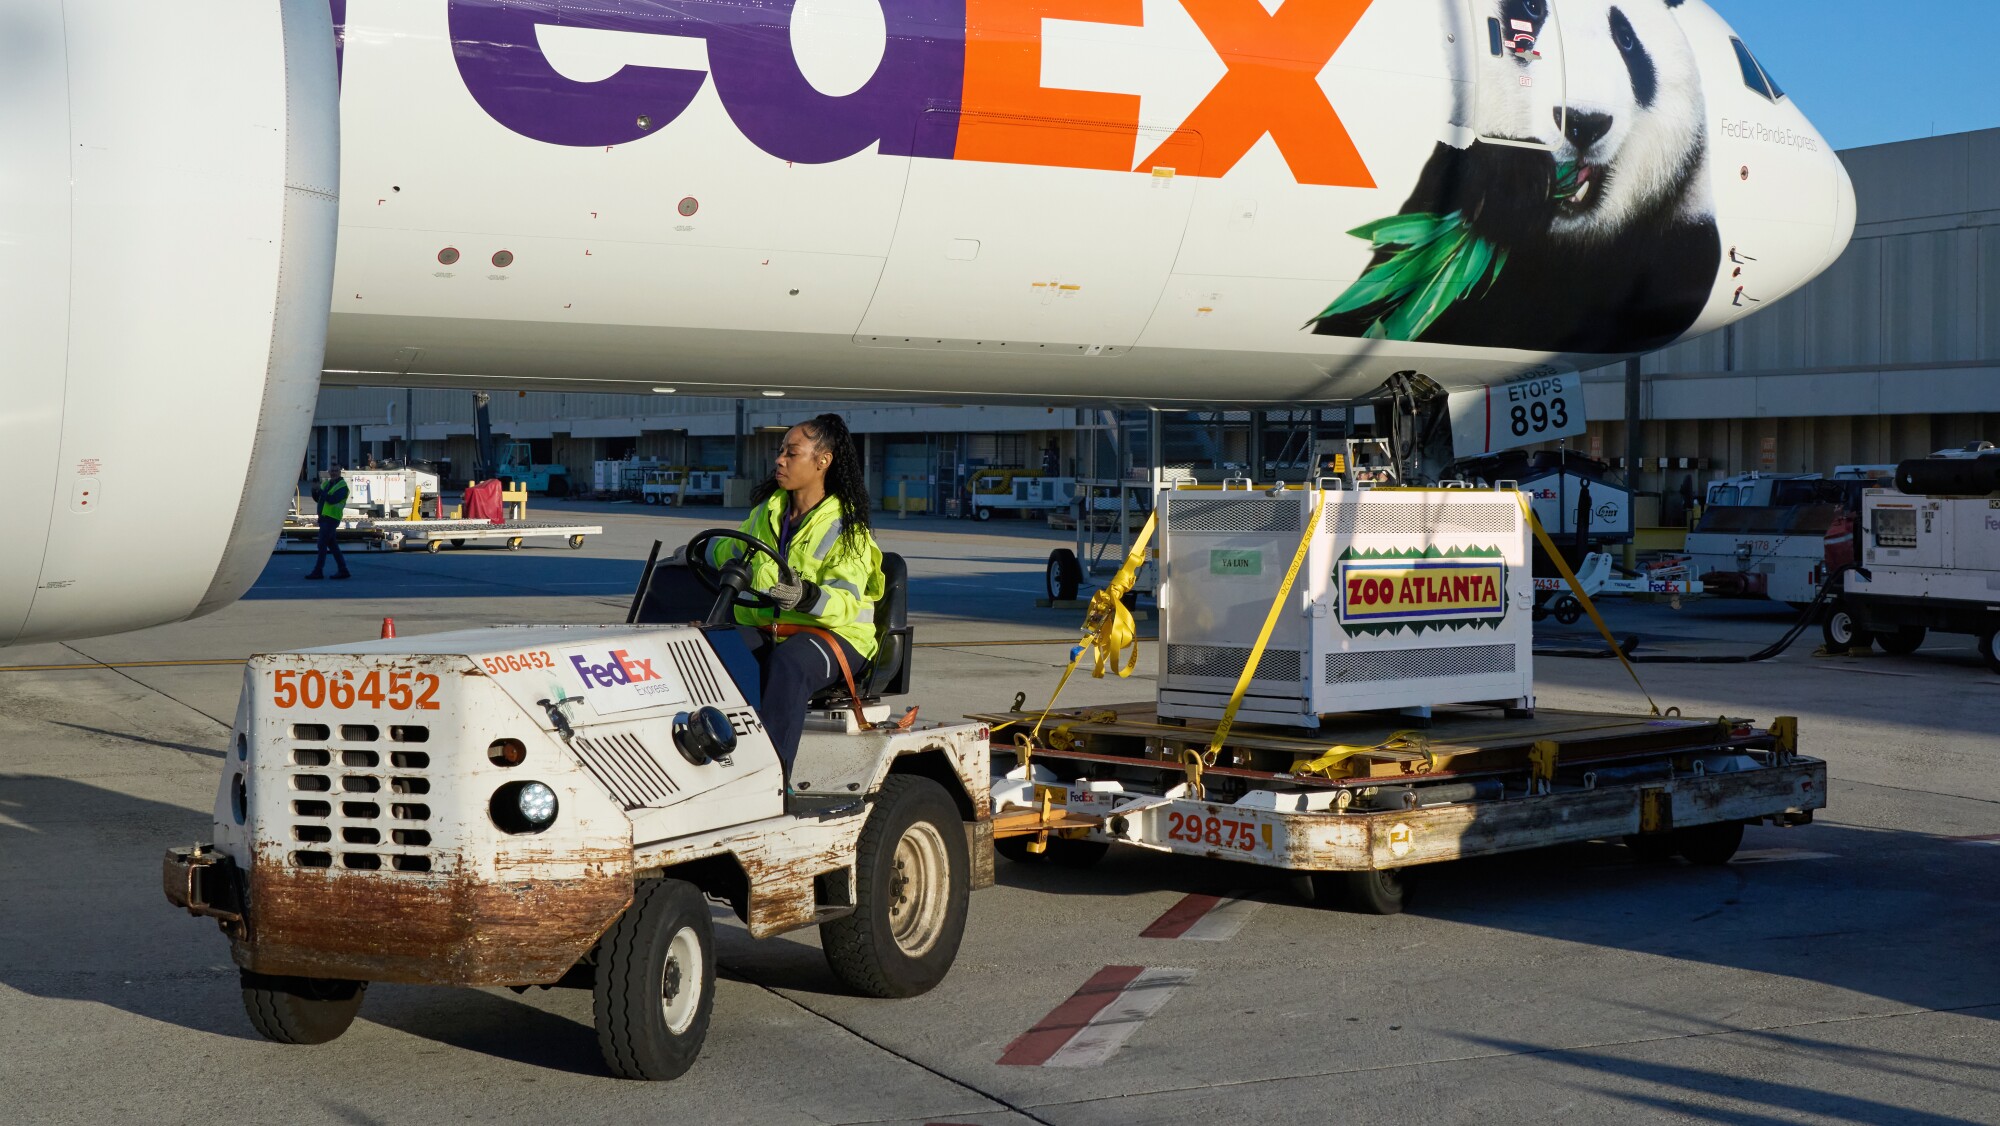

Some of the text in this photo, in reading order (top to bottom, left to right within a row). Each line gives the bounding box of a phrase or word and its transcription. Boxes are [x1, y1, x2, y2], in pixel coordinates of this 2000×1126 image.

[1720, 117, 1818, 152] FedEx Panda Express
[1507, 377, 1563, 402] ETOPS
[1510, 397, 1568, 437] 893
[1925, 519, 1932, 533] 2
[1985, 515, 2000, 531] Fe
[1222, 559, 1249, 567] YA LUN
[1297, 543, 1309, 562] EXP
[1347, 575, 1498, 605] ZOO ATLANTA
[1648, 580, 1680, 593] FedEx
[483, 651, 556, 675] 506452
[569, 649, 662, 690] FedEx
[274, 669, 440, 711] 506452
[634, 681, 669, 697] Express
[1070, 791, 1094, 803] FedEx
[1168, 811, 1256, 852] 29875
